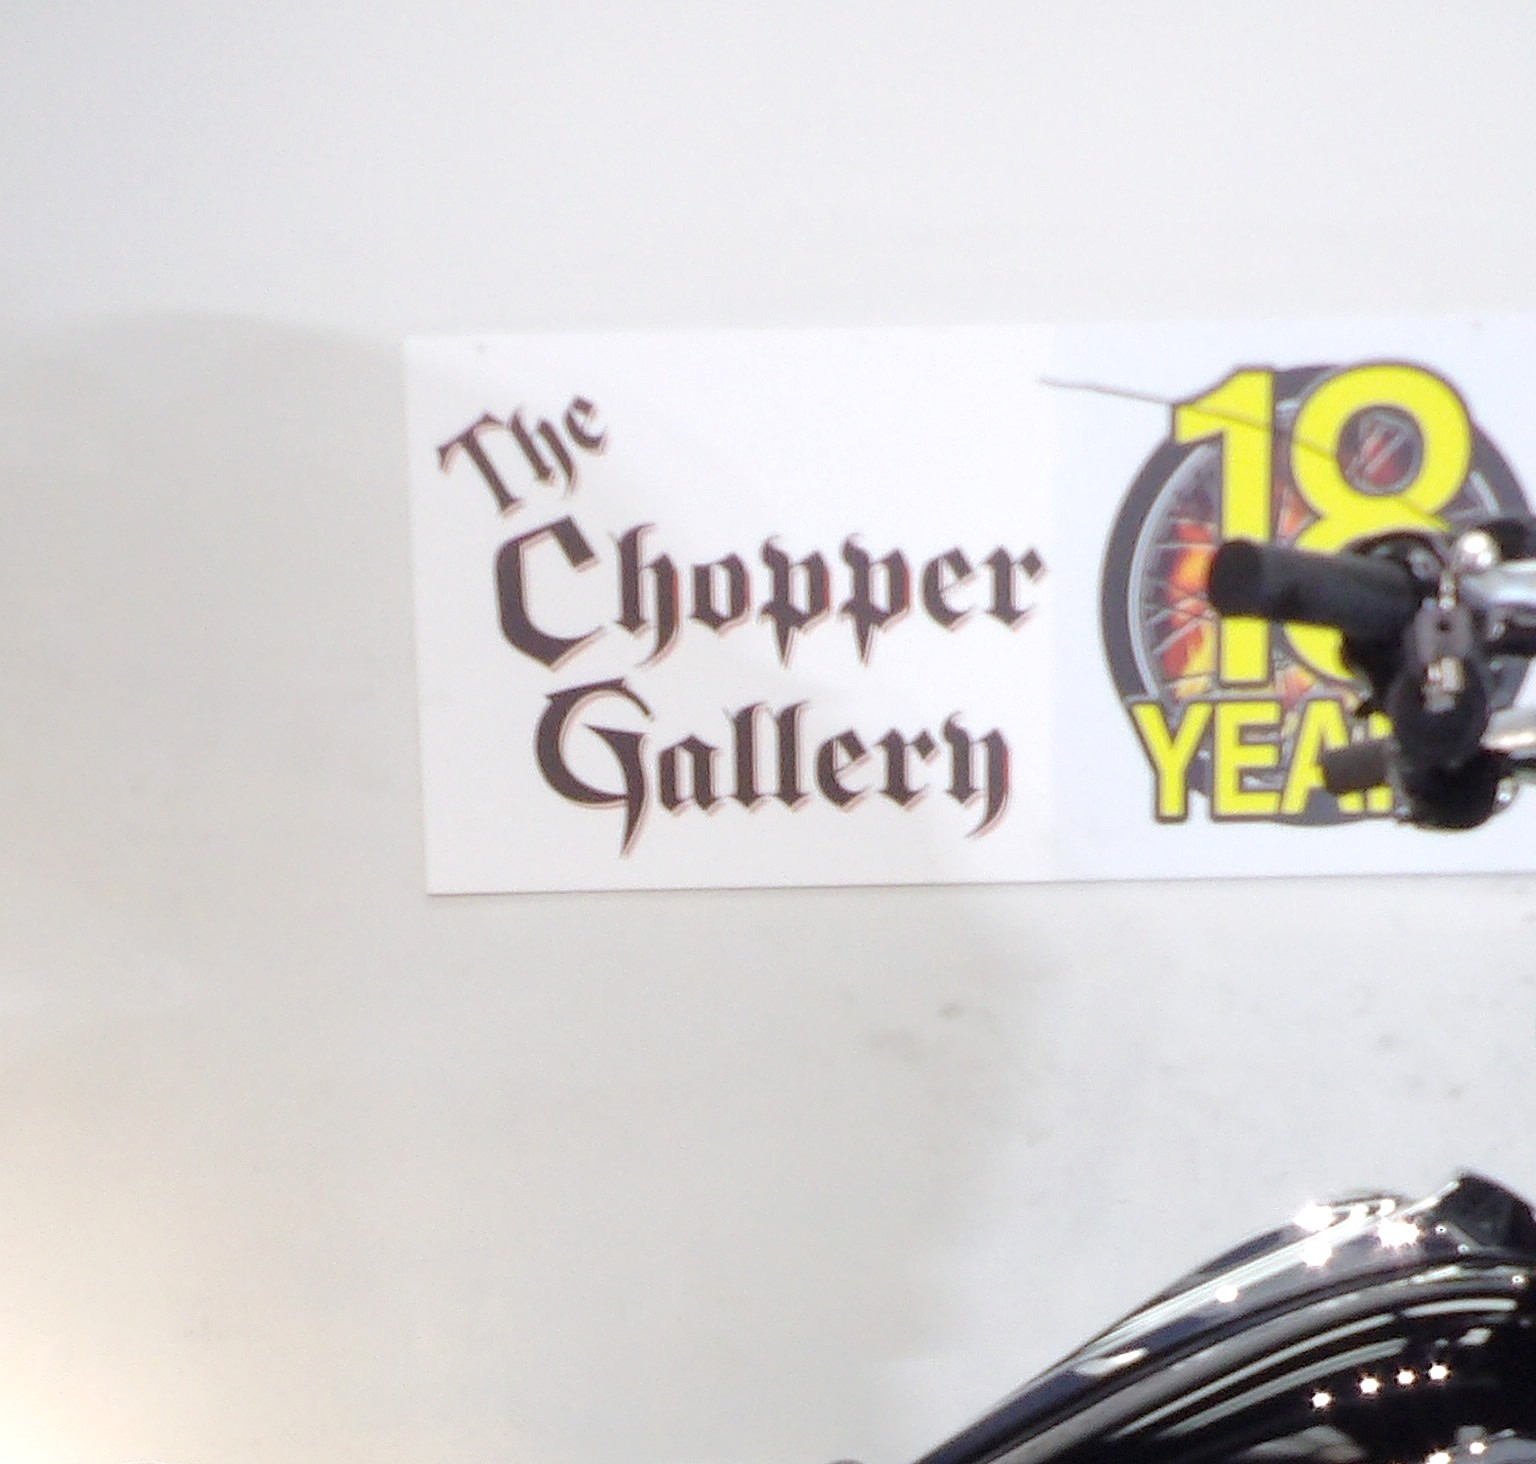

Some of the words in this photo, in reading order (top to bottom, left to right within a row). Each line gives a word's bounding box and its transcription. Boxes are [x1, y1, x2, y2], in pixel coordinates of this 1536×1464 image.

[438, 394, 610, 515] The
[1170, 358, 1474, 692] 18
[494, 514, 1048, 672] Chopper
[534, 677, 1011, 860] Gallery
